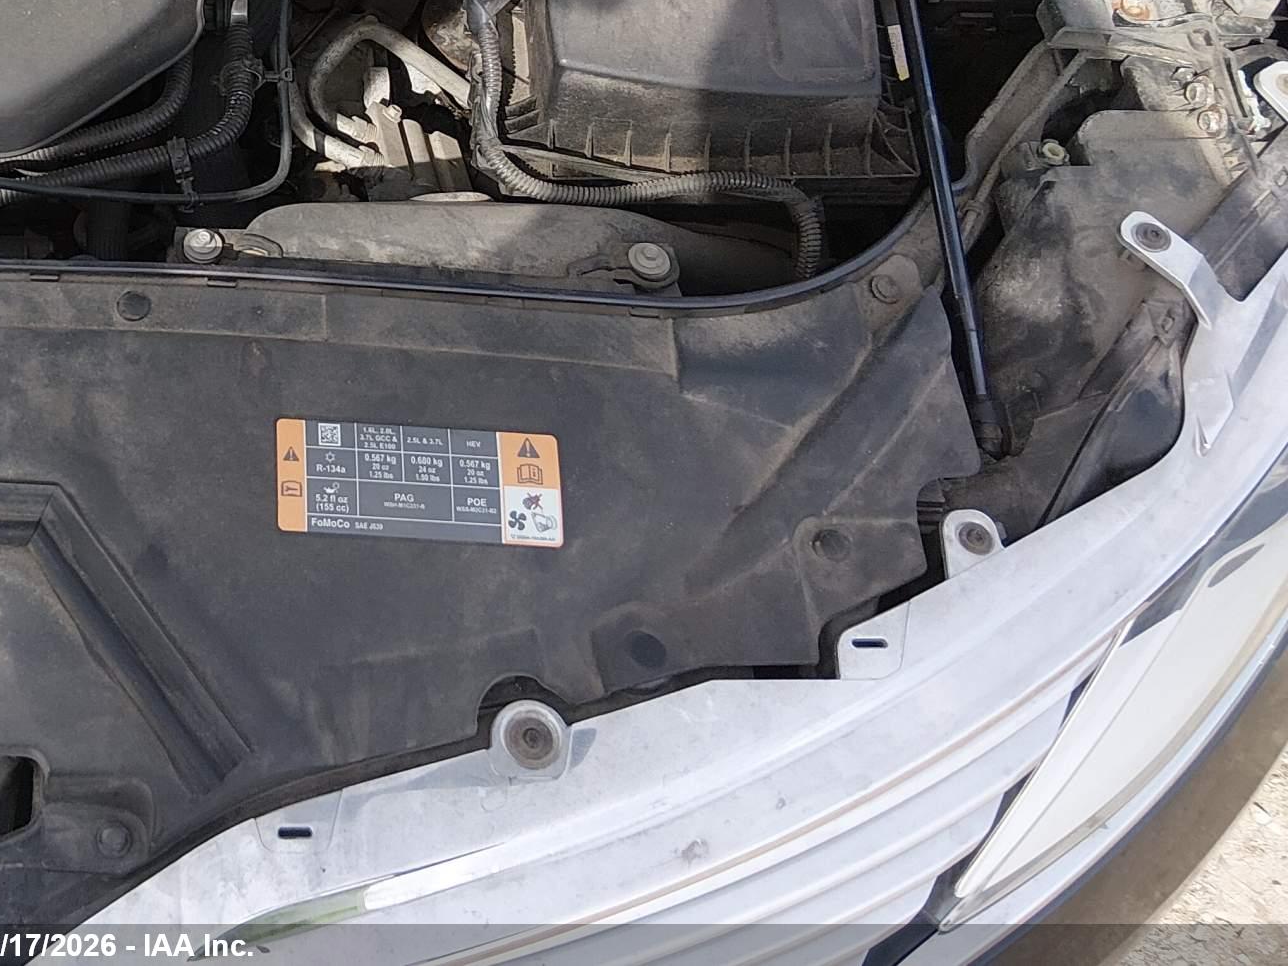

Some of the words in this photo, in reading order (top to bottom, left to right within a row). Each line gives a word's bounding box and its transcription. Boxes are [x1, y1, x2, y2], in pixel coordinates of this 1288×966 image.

[466, 440, 481, 448] HEV
[387, 454, 396, 465] kg
[433, 458, 443, 468] kg
[316, 464, 346, 474] R-134a
[481, 460, 491, 471] kg
[369, 470, 382, 478] 1.25
[315, 494, 328, 502] 5.2
[329, 494, 336, 503] fl
[337, 496, 349, 504] oz
[394, 493, 414, 503] PAG
[467, 497, 487, 507] POE
[316, 503, 334, 512] (155
[335, 504, 350, 514] cc)
[311, 517, 351, 529] FoMoCo
[355, 521, 368, 530] SAE
